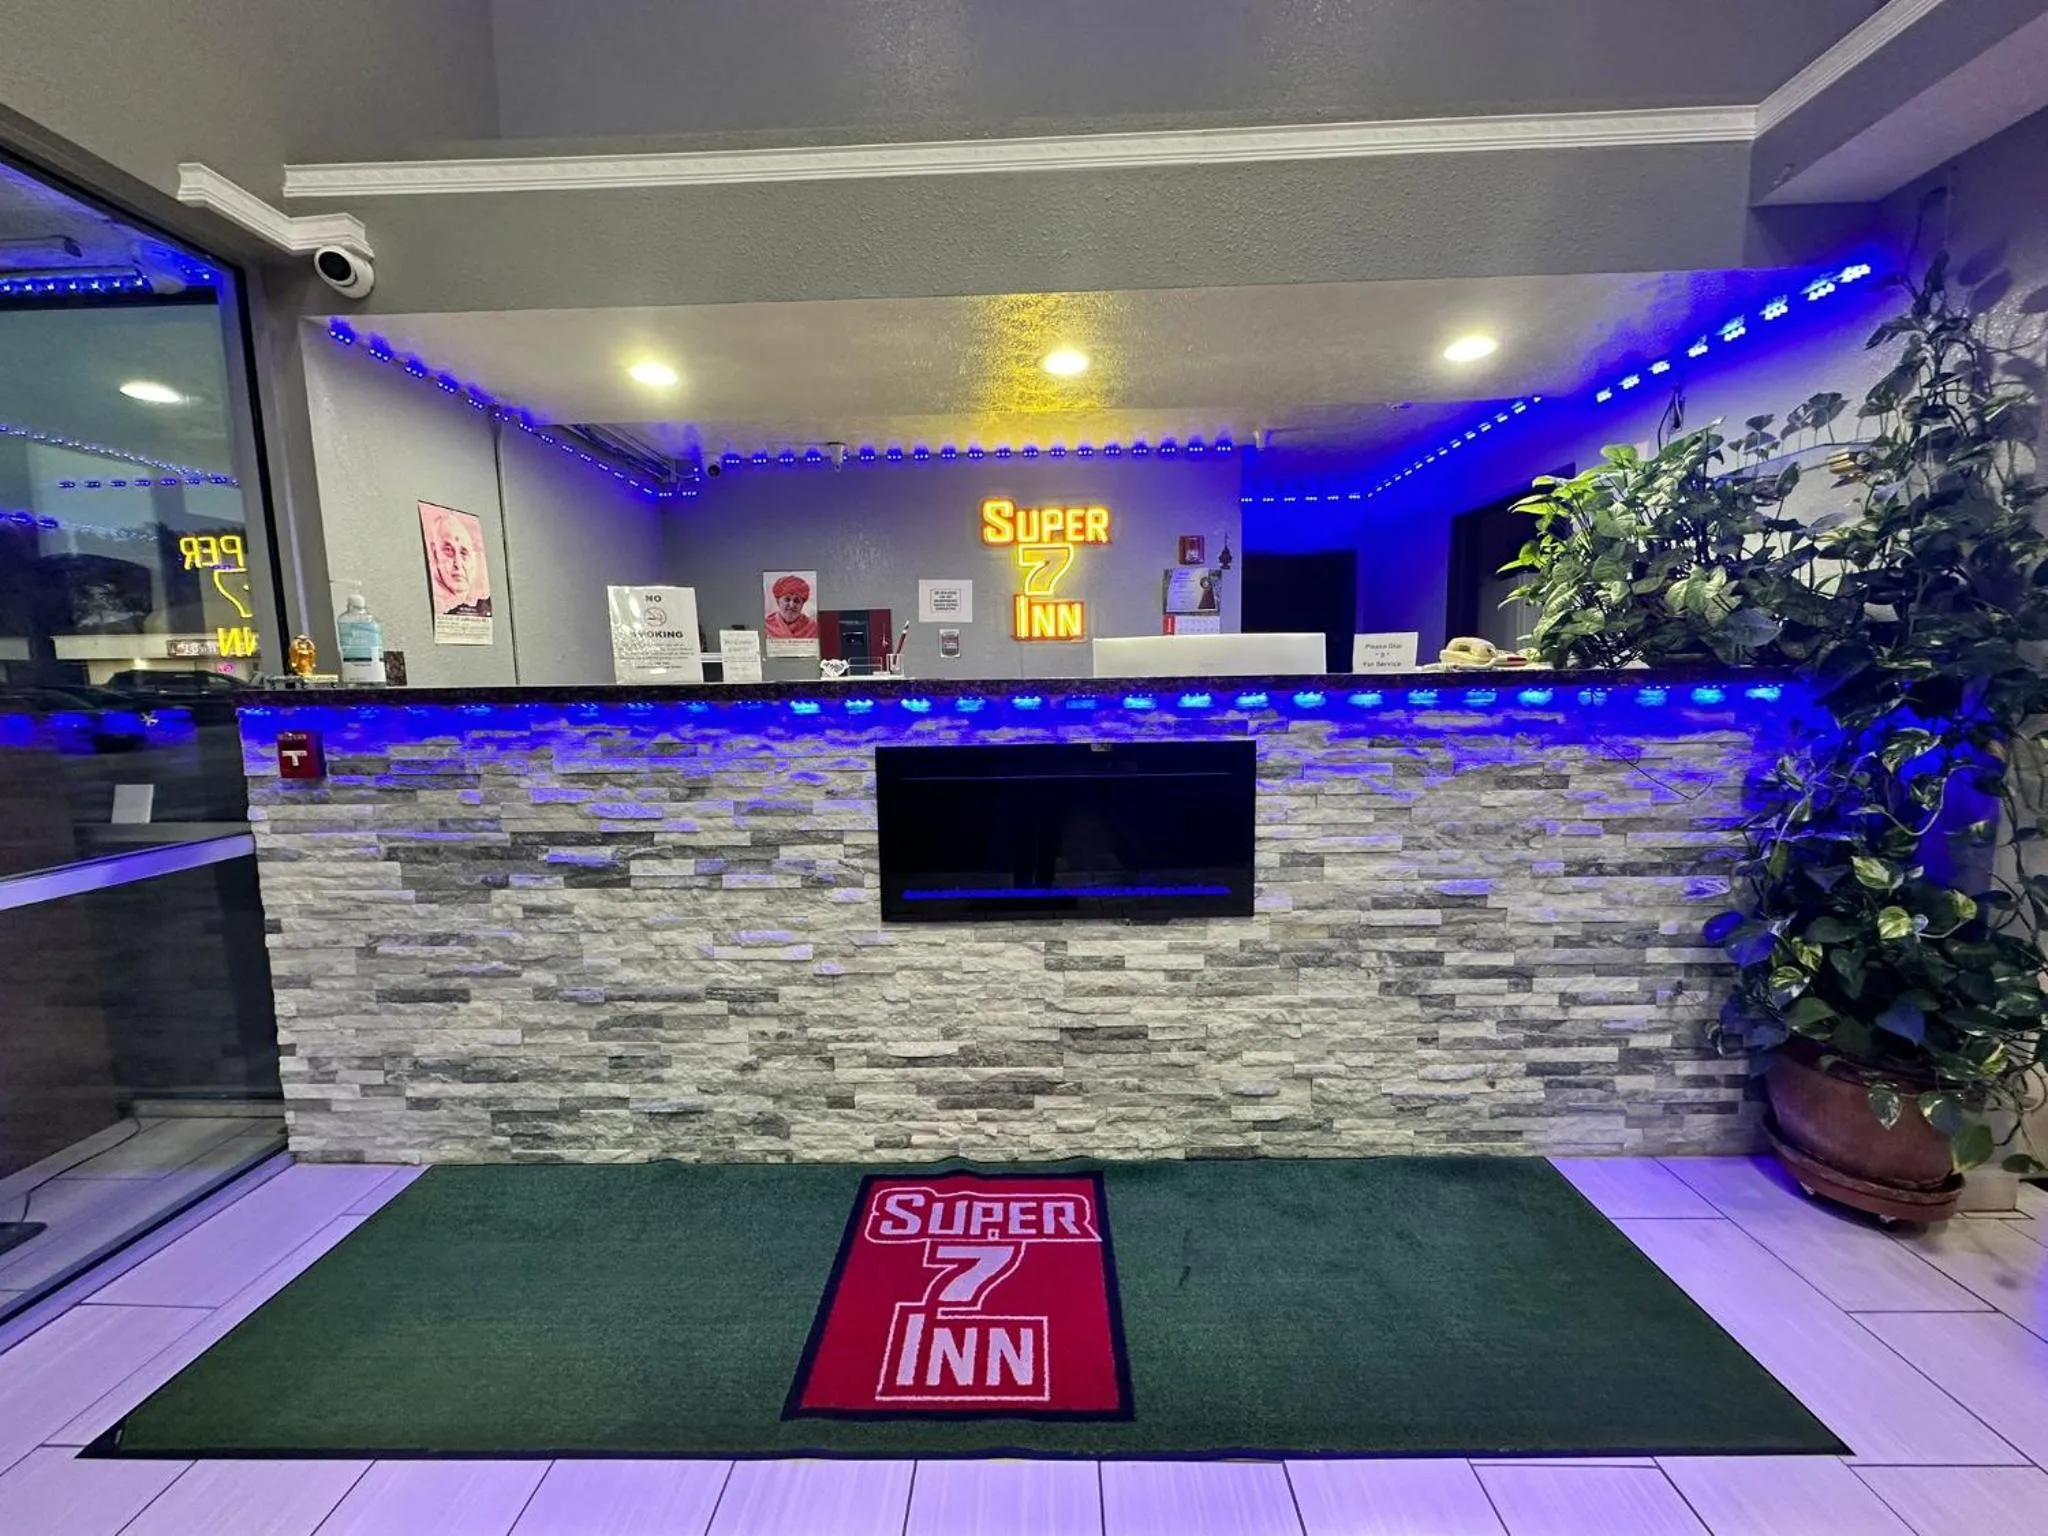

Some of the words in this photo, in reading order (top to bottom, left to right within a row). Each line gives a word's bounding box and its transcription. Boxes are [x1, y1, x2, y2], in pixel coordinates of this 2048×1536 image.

[983, 499, 1110, 544] SUPER
[1018, 543, 1074, 595] 7
[645, 594, 662, 603] NO
[1014, 594, 1083, 638] INN
[632, 630, 684, 639] OKING
[880, 1193, 1081, 1235] SUPER
[936, 1246, 1015, 1302] 7
[895, 1313, 1035, 1386] INN
